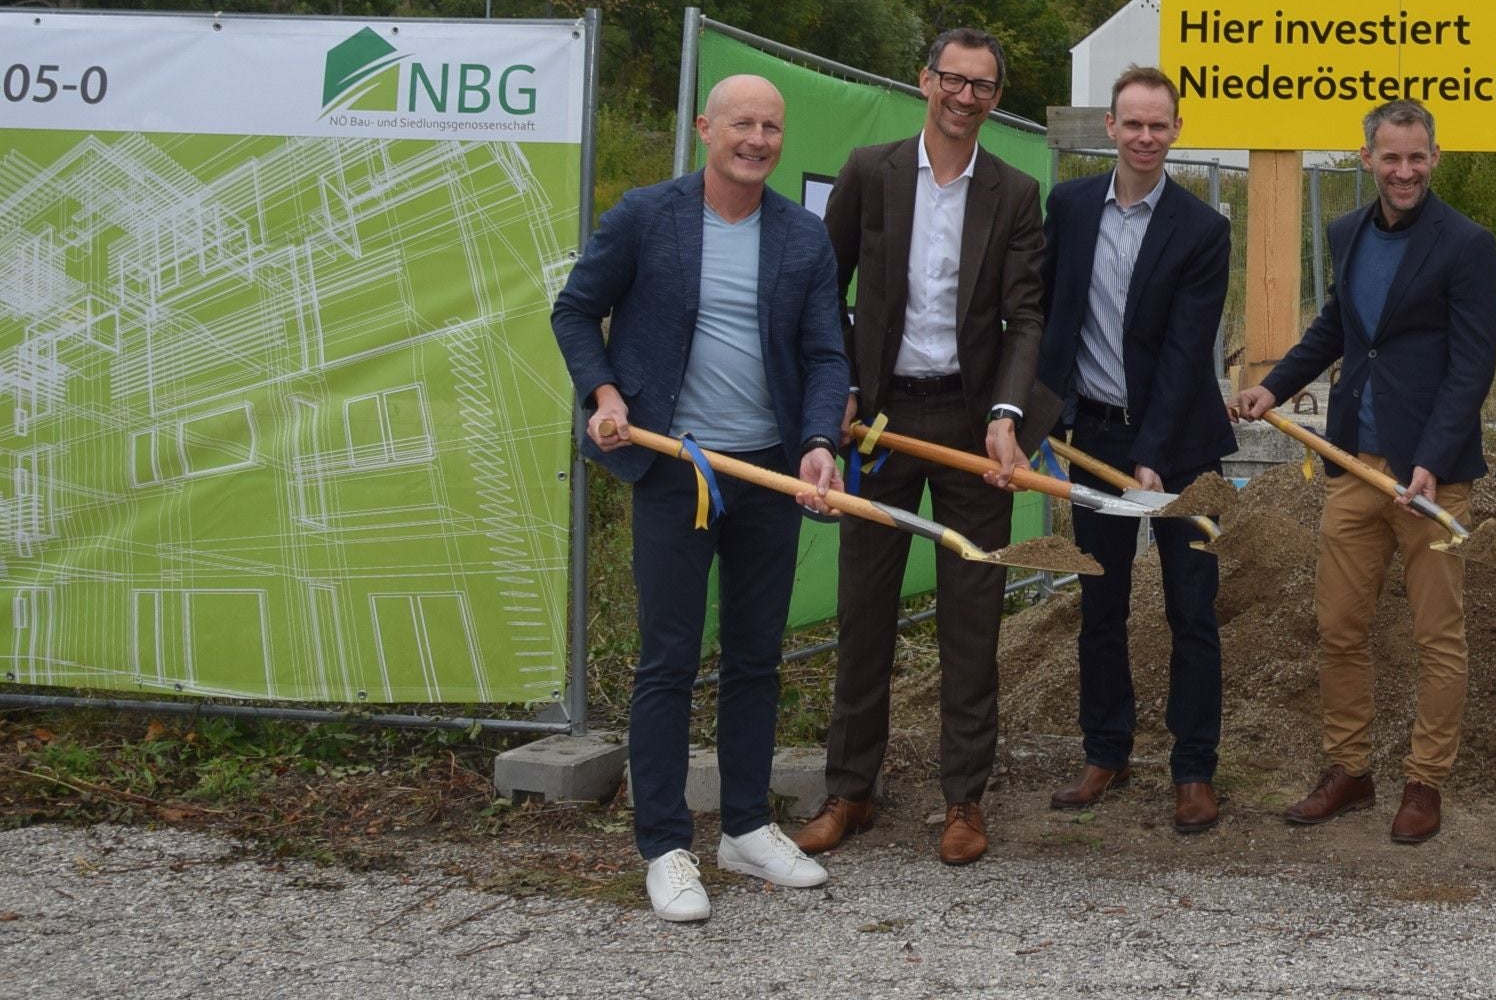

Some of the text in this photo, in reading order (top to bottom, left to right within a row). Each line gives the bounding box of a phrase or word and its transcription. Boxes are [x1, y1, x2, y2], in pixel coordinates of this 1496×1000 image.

[1181, 10, 1470, 45] Hier investiert
[0, 63, 107, 104] 05-0
[409, 62, 536, 115] NBG
[351, 117, 374, 128] Bau-
[377, 117, 397, 129] und
[400, 117, 536, 132] Siedlungsgenossenschaft
